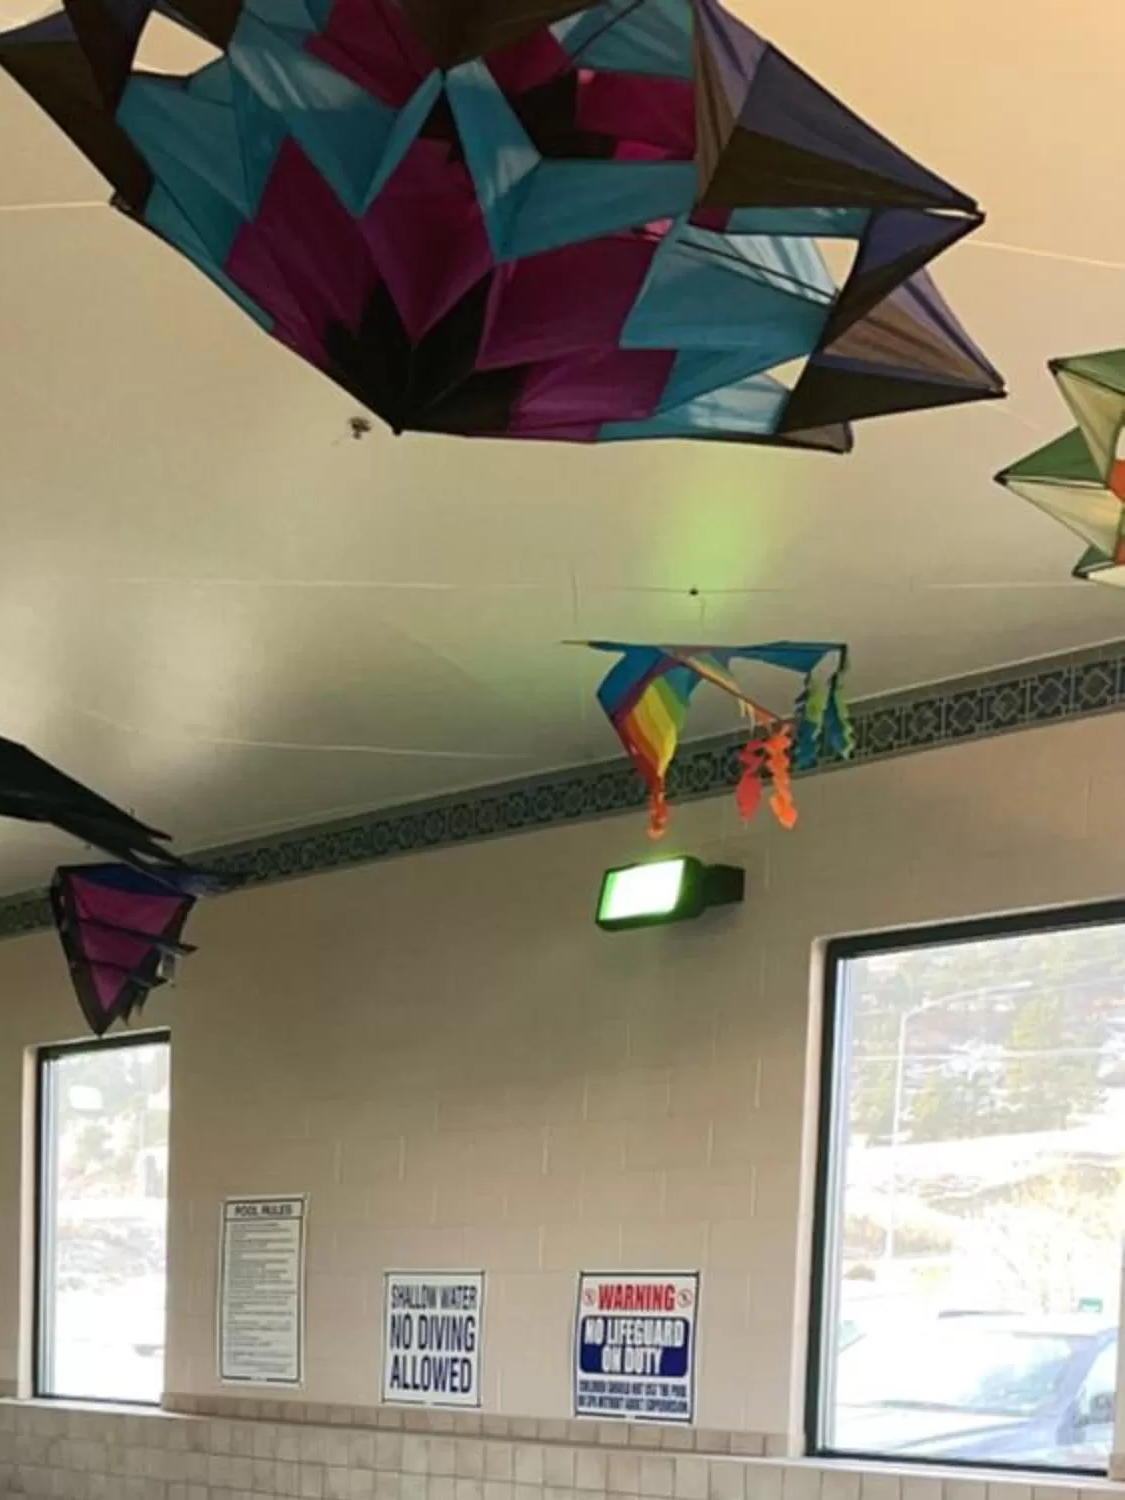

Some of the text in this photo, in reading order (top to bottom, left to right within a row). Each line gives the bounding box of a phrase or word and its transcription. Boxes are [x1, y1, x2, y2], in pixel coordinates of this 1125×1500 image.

[234, 1203, 293, 1217] POOL RULES
[391, 1284, 477, 1310] SHALLOW WATER
[598, 1283, 676, 1311] WARNING
[390, 1313, 476, 1352] NO DIVING
[584, 1317, 685, 1348] NO LIFEGUARD
[389, 1354, 473, 1393] ALLOWED
[601, 1345, 663, 1375] ON DUTY
